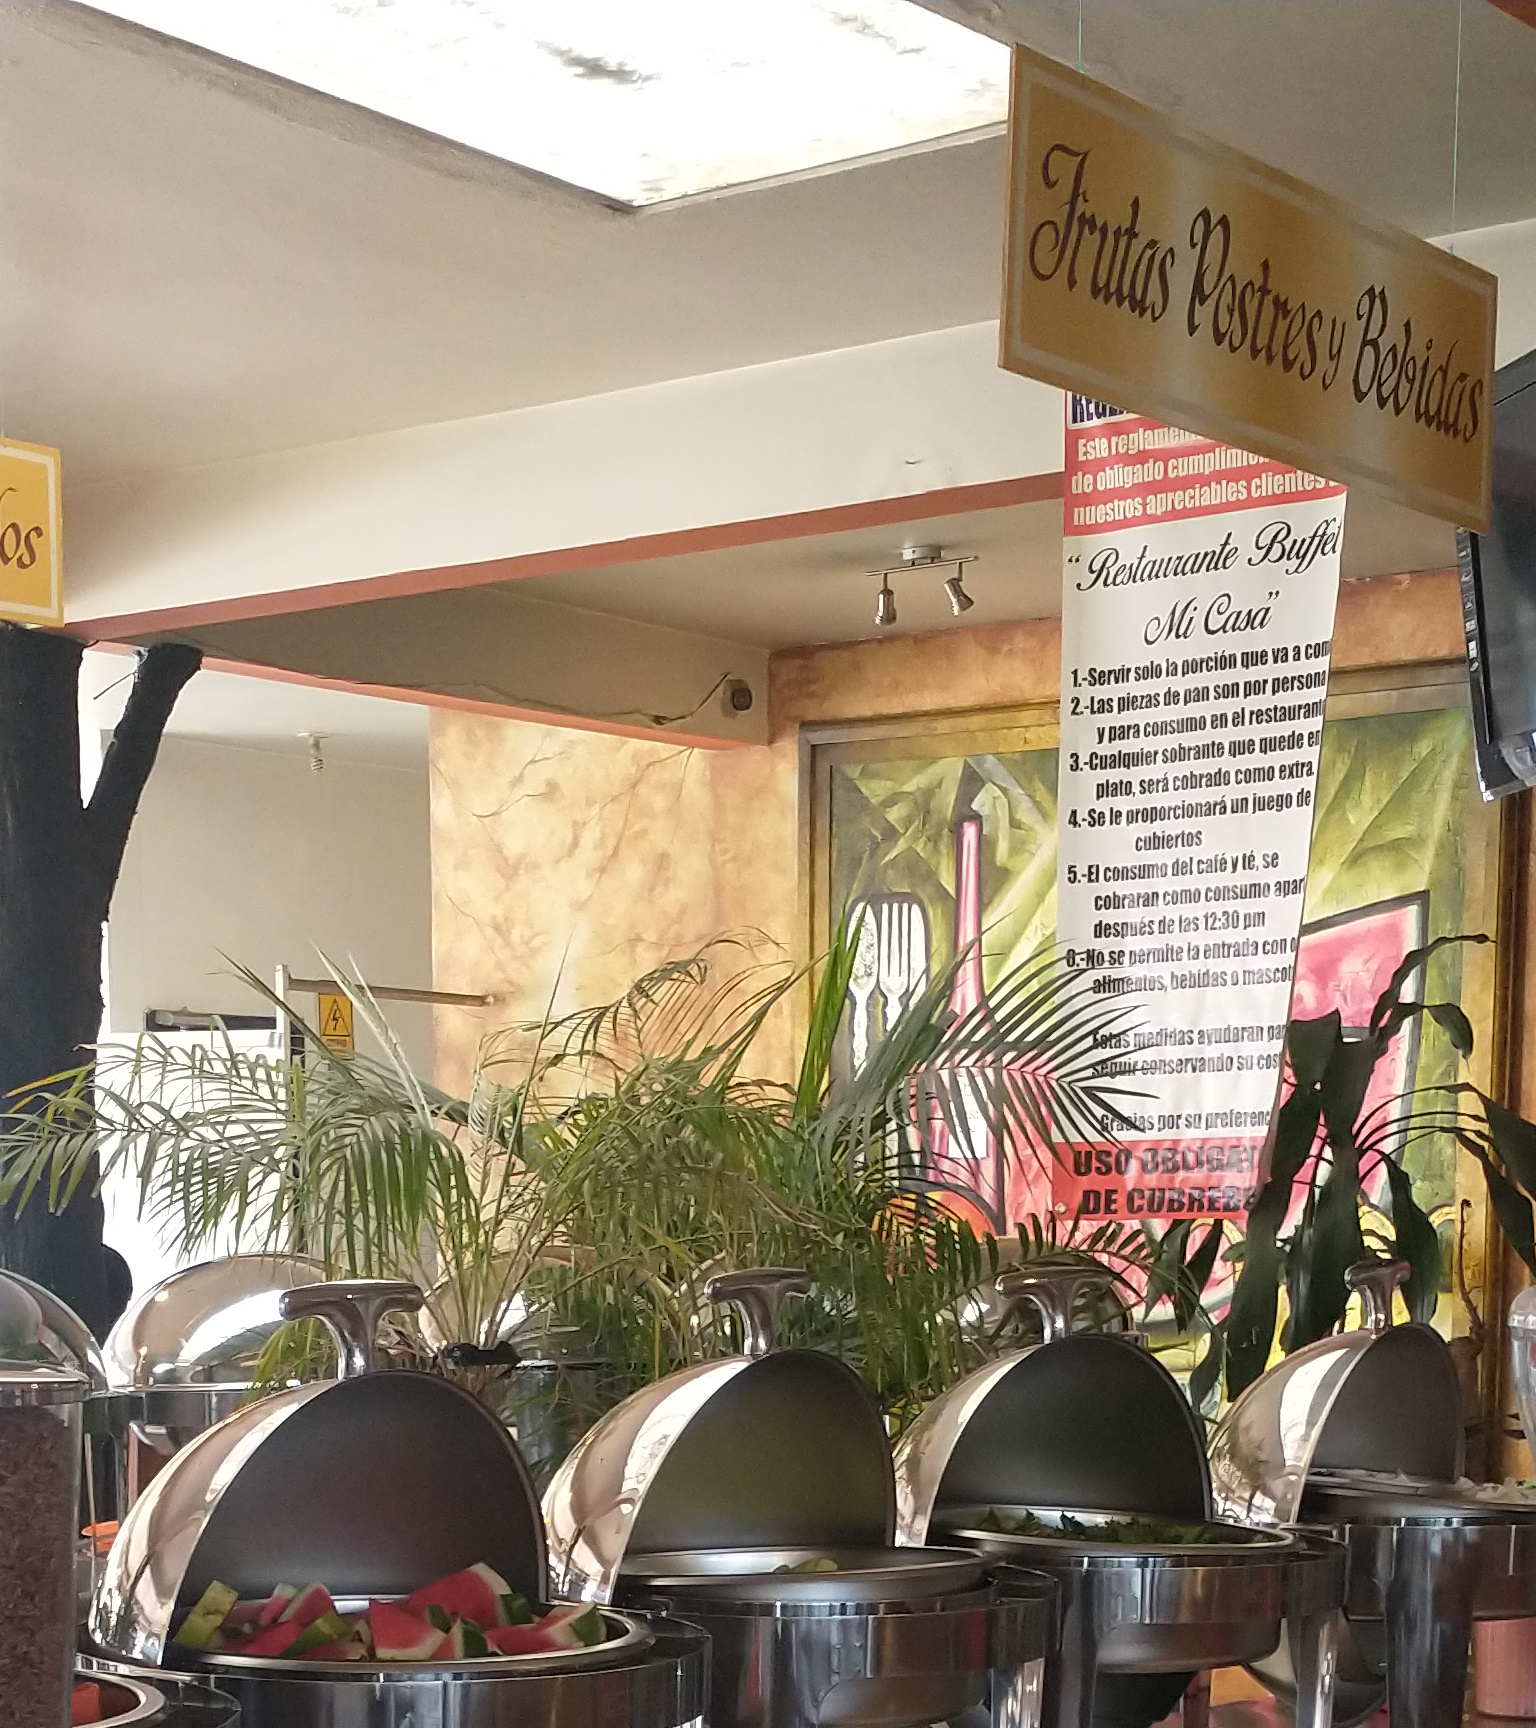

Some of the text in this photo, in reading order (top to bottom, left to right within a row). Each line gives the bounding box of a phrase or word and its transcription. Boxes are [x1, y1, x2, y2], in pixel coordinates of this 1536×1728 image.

[1029, 143, 1485, 445] Frutas Postres y Bebidas
[1078, 438, 1109, 462] Este
[1072, 471, 1093, 495] de
[1096, 458, 1165, 492] obligado
[1073, 469, 1327, 526] nuestros apreciables clientes
[1144, 596, 1198, 646] Mi
[1134, 662, 1162, 682] solo
[1165, 658, 1179, 678] la
[1181, 650, 1237, 677] porción
[1241, 649, 1269, 670] que
[1272, 646, 1289, 665] va
[1292, 644, 1301, 662] a
[1071, 695, 1114, 716] 2.-Las
[1117, 691, 1161, 715] piezas
[1163, 686, 1180, 707] de
[1183, 685, 1210, 706] pan
[1213, 682, 1240, 701] son
[1243, 677, 1269, 700] por
[1096, 698, 1324, 745] y para consumo en el restaurant
[1161, 739, 1225, 765] sobrante
[1228, 737, 1256, 758] que
[1259, 729, 1304, 755] quede
[1096, 778, 1136, 801] plato,
[1139, 772, 1169, 794] será
[1172, 767, 1231, 792] cobrado
[1234, 765, 1275, 785] como
[1109, 806, 1122, 826] le
[1126, 795, 1228, 826] proporcionará
[1230, 796, 1249, 814] un
[1251, 792, 1293, 815] juego
[1296, 787, 1311, 807] de
[1135, 830, 1203, 852] cubiertos
[1103, 863, 1168, 883] consumo
[1171, 856, 1194, 877] del
[1196, 852, 1228, 875] café
[1230, 856, 1239, 874] y
[1241, 850, 1259, 872] té,
[1262, 851, 1279, 868] se
[1094, 890, 1159, 911] cobraran
[1162, 887, 1201, 906] como
[1205, 881, 1271, 903] consumo
[1093, 909, 1265, 939] después de las 12:30 pm
[1108, 949, 1126, 966] se
[1129, 944, 1183, 968] permite
[1186, 942, 1200, 961] la
[1203, 938, 1259, 960] entrada
[1262, 938, 1287, 956] con
[1170, 969, 1227, 990] bebidas
[1231, 970, 1239, 985] o
[1133, 1027, 1194, 1048] medidas
[1197, 1025, 1264, 1047] ayudaran
[1141, 1053, 1233, 1076] conservando
[1236, 1054, 1253, 1071] su
[1158, 1113, 1182, 1131] por
[1184, 1112, 1202, 1129] su
[1073, 1149, 1132, 1177] USO
[1082, 1189, 1119, 1215] DE
